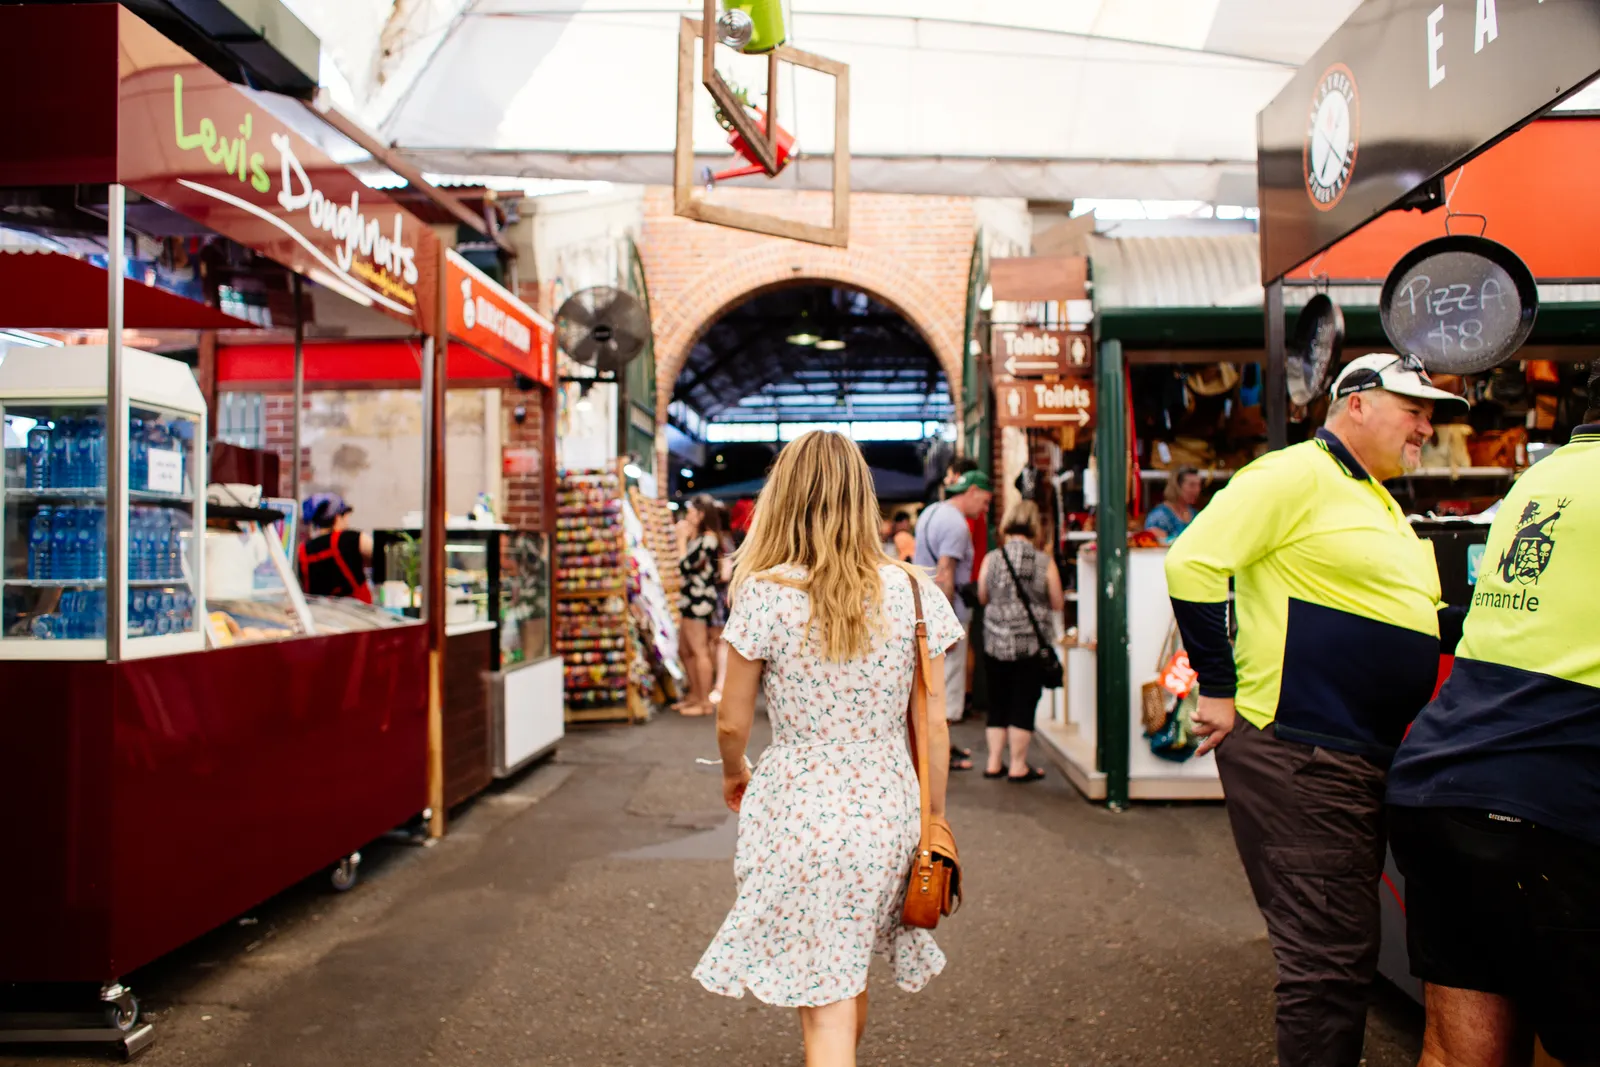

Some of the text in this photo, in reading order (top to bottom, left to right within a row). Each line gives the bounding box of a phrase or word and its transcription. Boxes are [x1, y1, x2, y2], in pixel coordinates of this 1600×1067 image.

[1321, 72, 1354, 104] STREET
[174, 73, 418, 284] Levi's Doughnuts
[1308, 171, 1336, 203] STREET
[1003, 331, 1060, 357] Toilets
[1427, 319, 1484, 357] $8
[1033, 383, 1091, 409] Toilets
[1474, 588, 1540, 613] emantle
